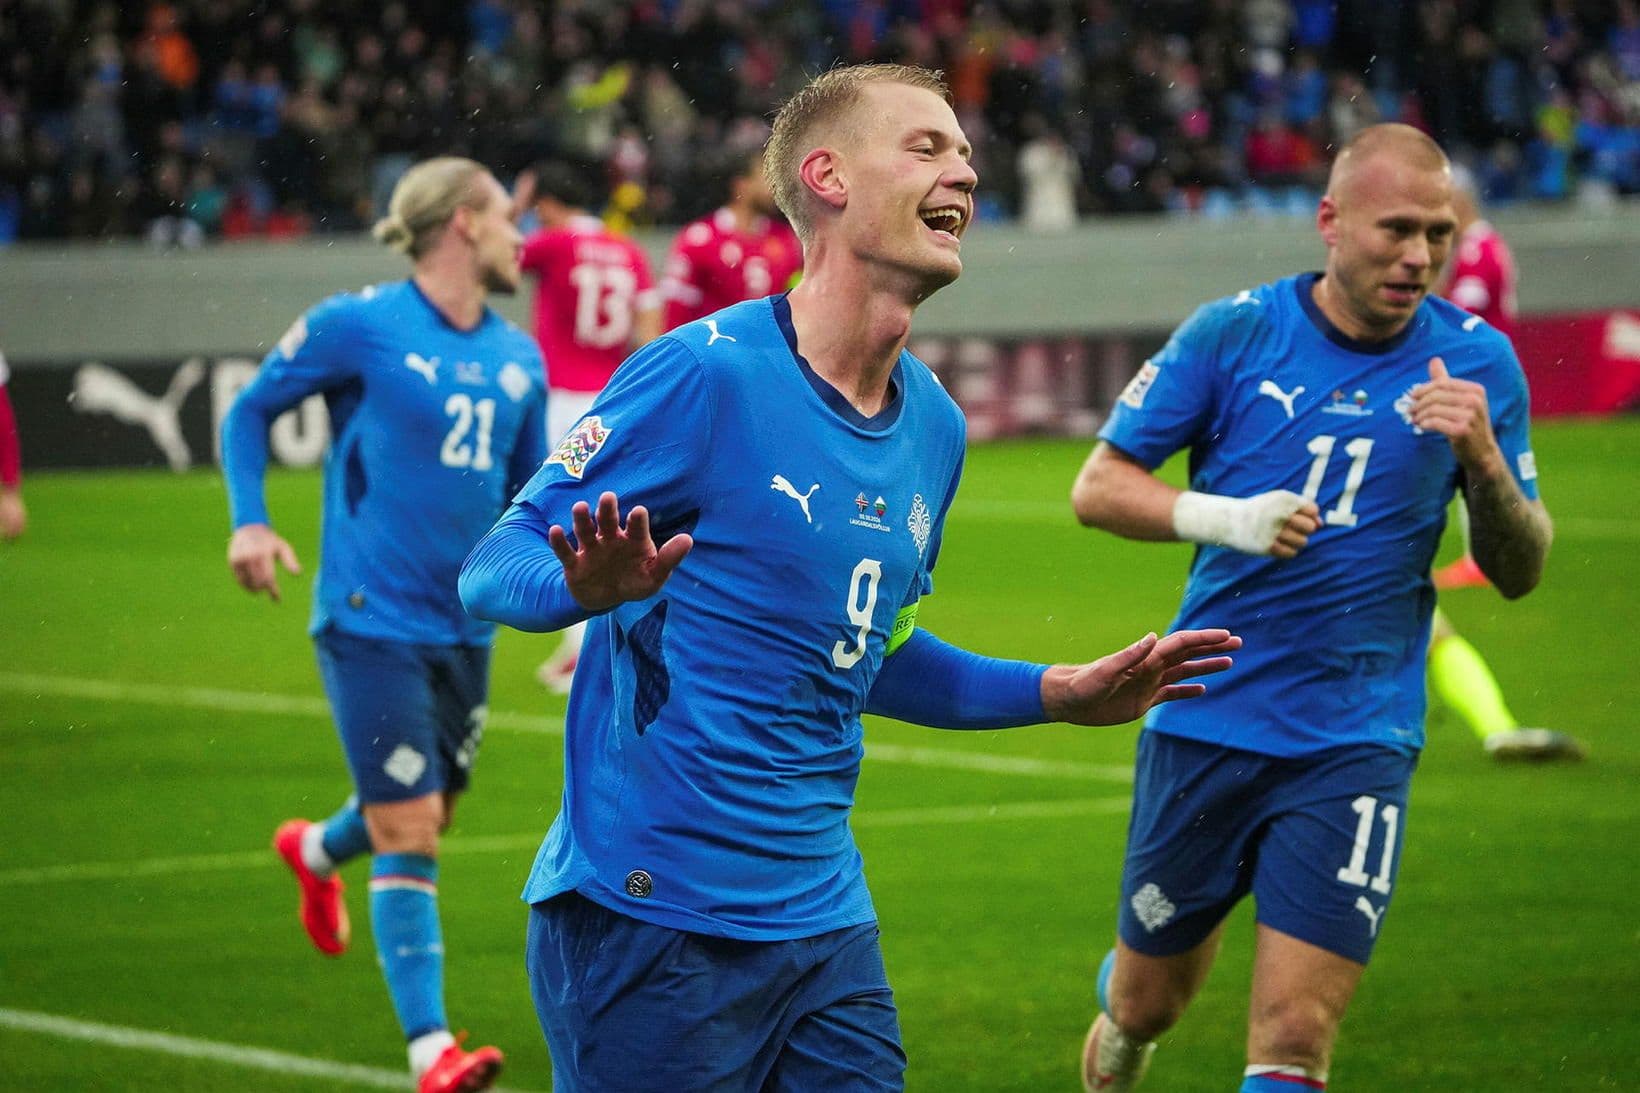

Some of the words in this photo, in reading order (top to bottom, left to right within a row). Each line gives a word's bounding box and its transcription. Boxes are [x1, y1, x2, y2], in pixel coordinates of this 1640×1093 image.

[570, 264, 637, 347] 13
[440, 393, 497, 471] 21
[1302, 435, 1375, 527] 11
[832, 558, 882, 669] 9
[1337, 795, 1399, 895] 11
